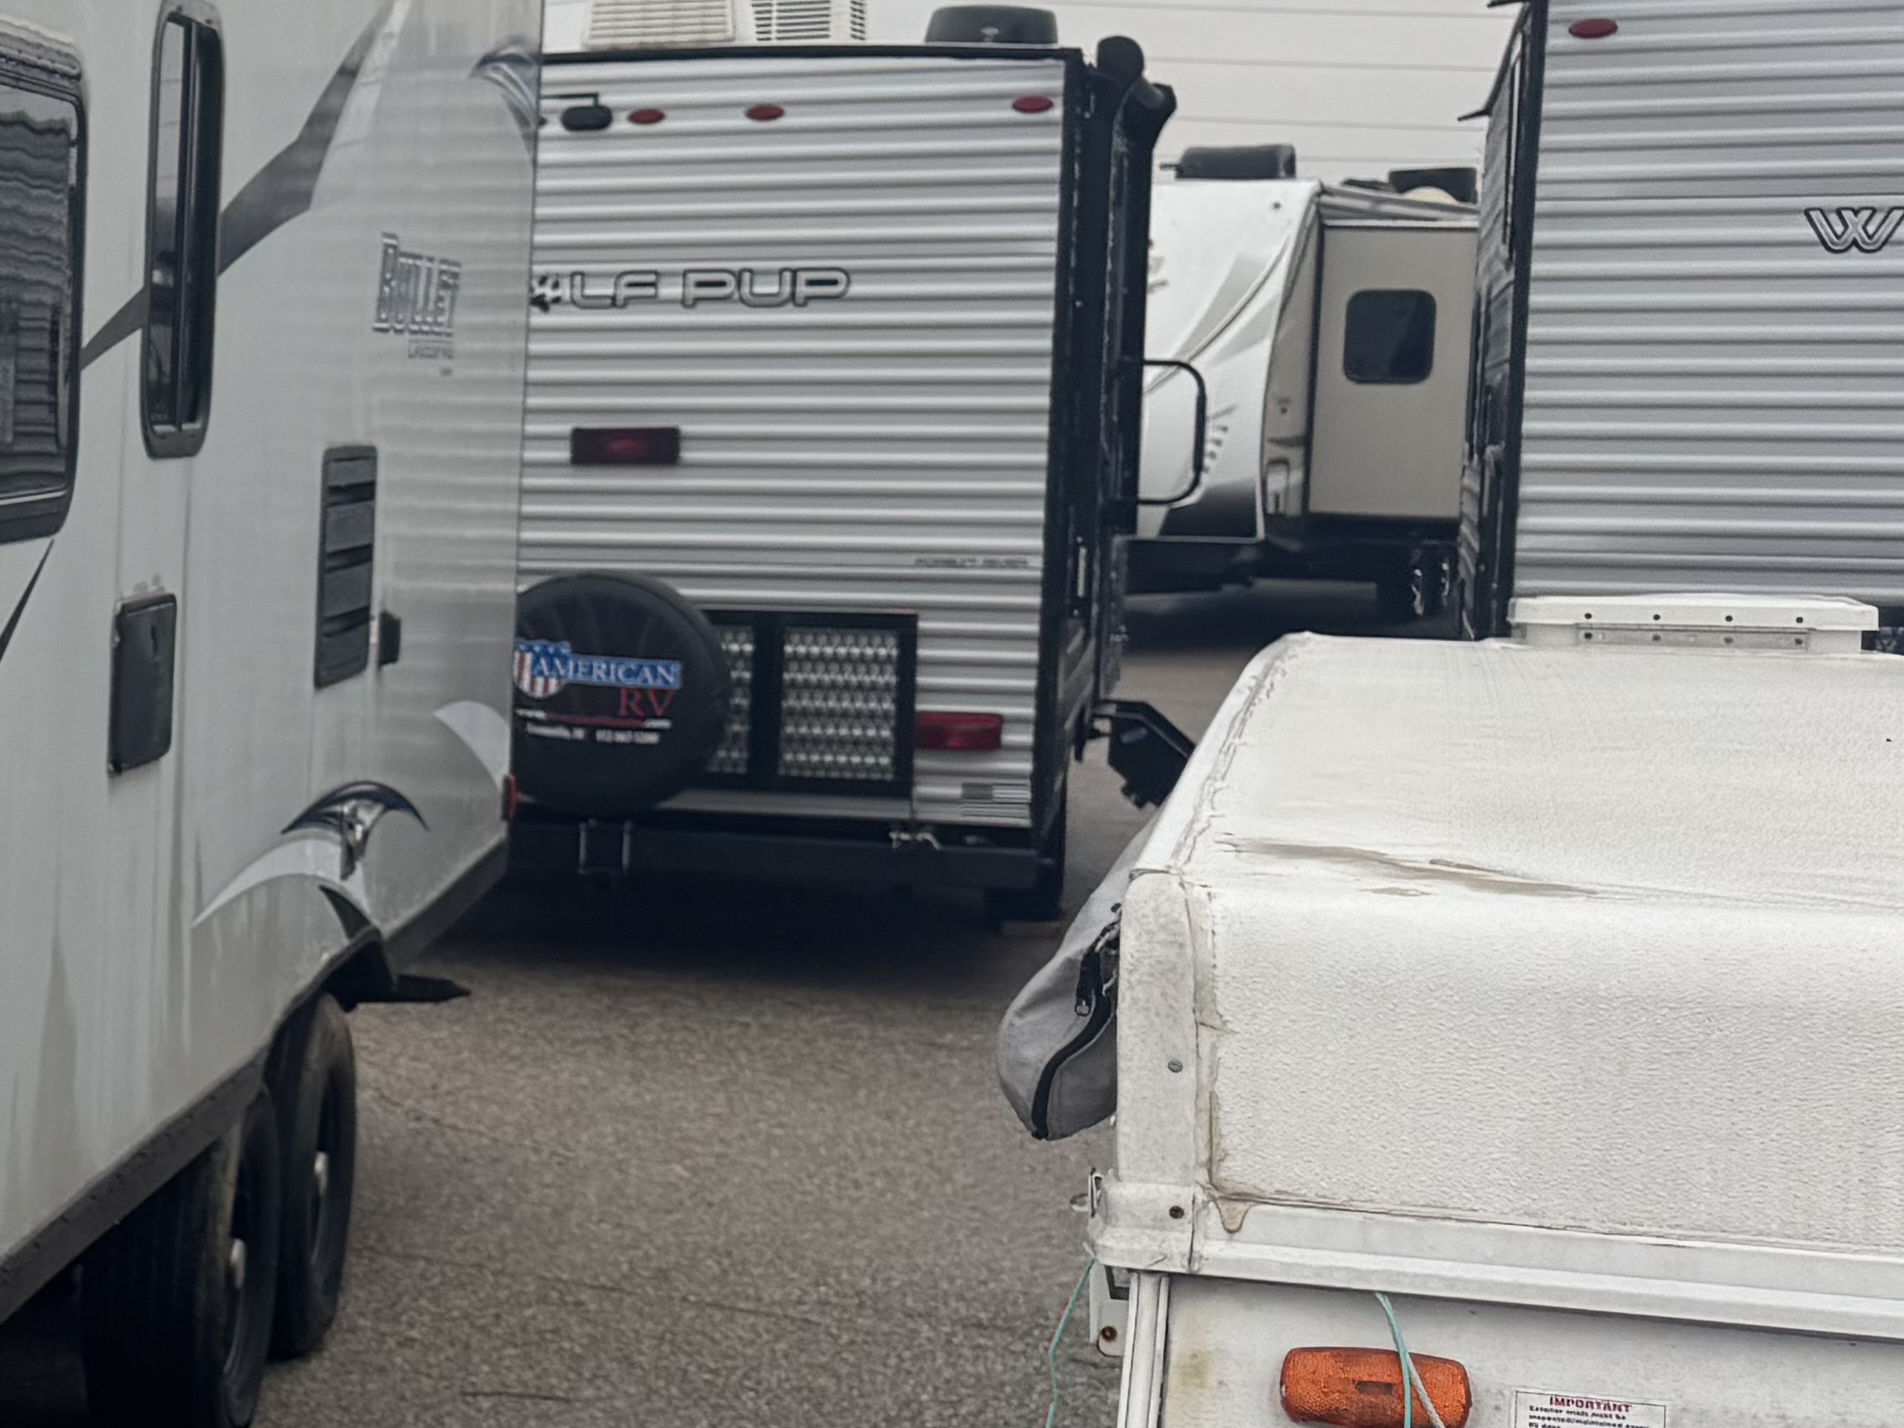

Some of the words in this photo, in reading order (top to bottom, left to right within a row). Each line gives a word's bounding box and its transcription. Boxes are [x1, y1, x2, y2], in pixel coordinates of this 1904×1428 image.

[681, 267, 851, 308] PUP
[533, 655, 677, 686] AMERICAN
[618, 687, 676, 717] RV
[1549, 1396, 1631, 1412] IMPORTANT
